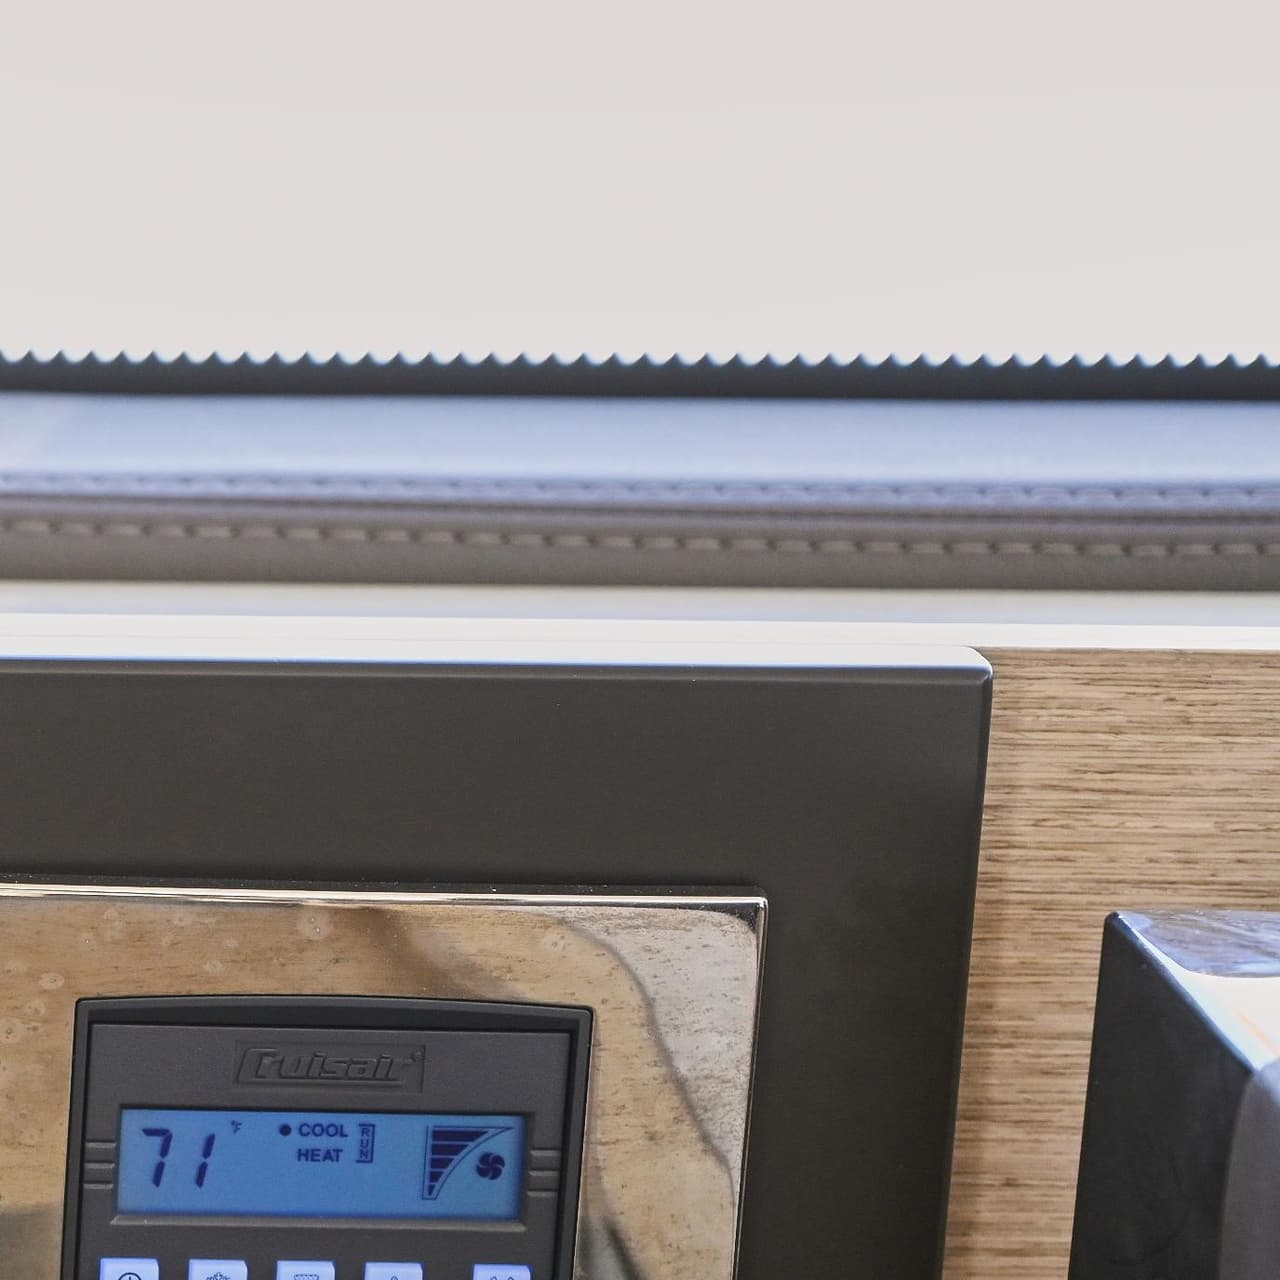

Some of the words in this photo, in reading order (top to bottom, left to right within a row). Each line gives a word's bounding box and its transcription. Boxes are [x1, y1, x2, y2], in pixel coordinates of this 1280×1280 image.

[236, 1047, 414, 1089] Cruisair
[298, 1122, 349, 1138] COOL
[359, 1126, 371, 1160] RUN
[142, 1127, 216, 1189] 71
[297, 1148, 344, 1163] HEAT
